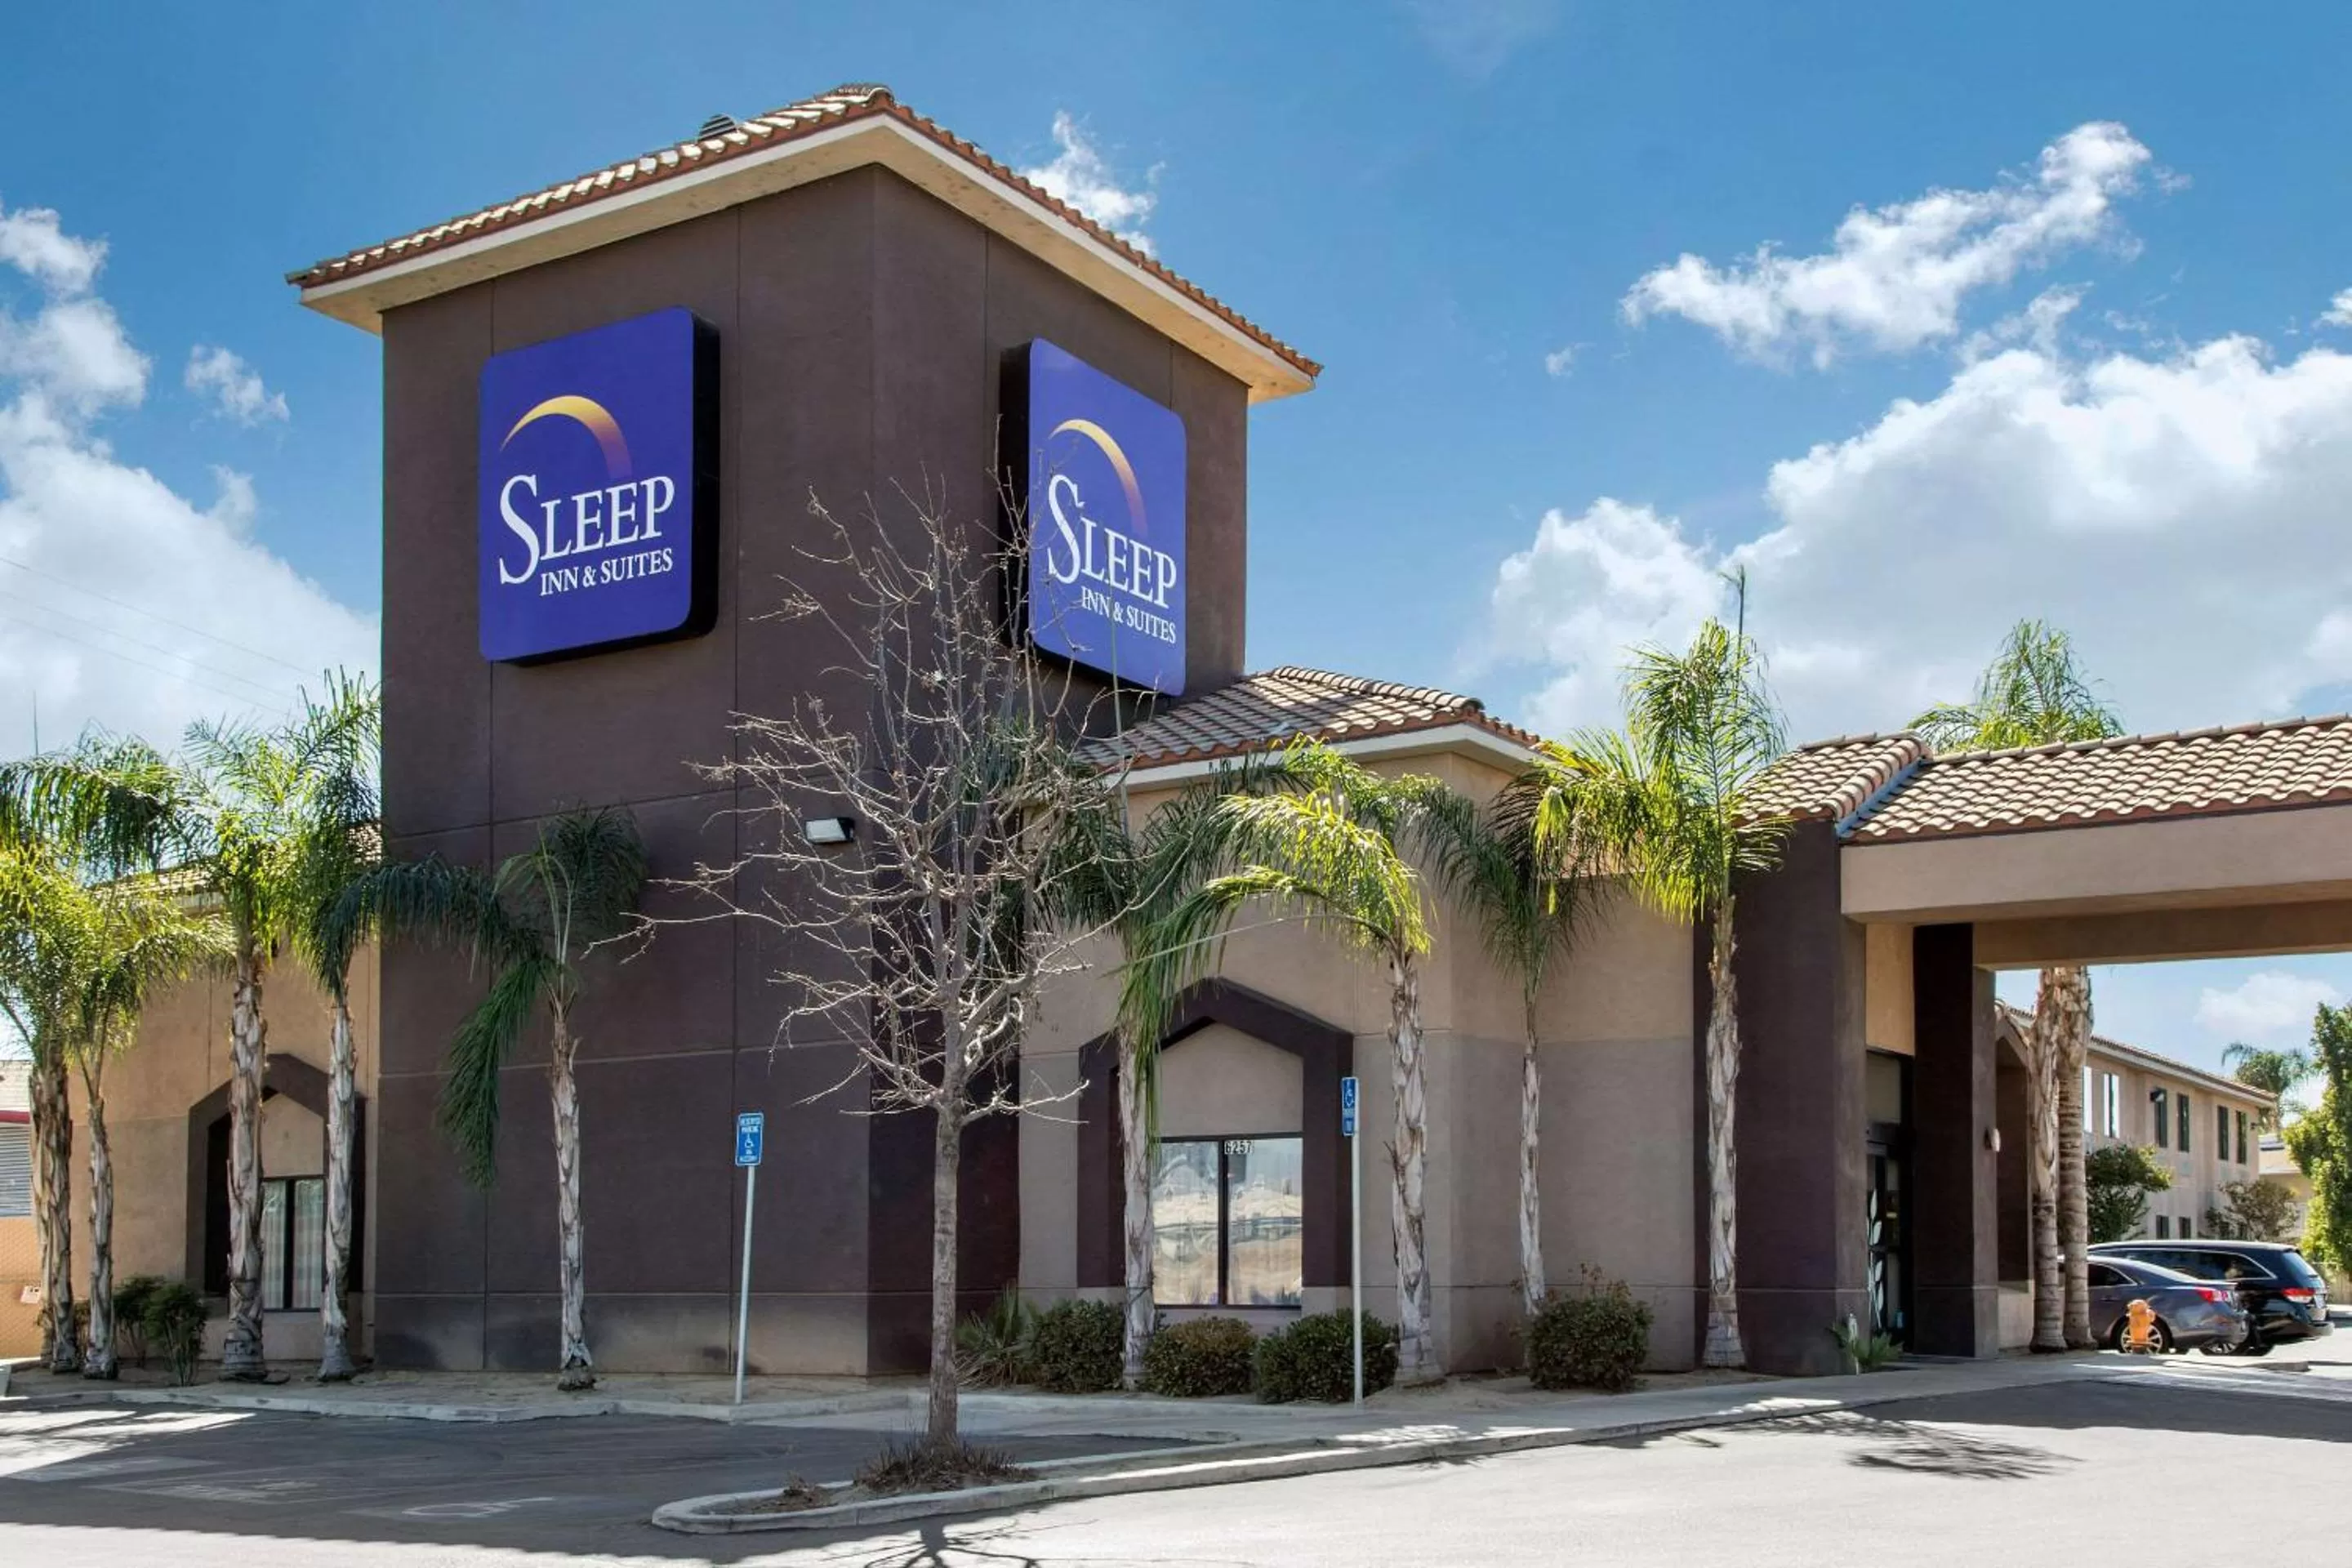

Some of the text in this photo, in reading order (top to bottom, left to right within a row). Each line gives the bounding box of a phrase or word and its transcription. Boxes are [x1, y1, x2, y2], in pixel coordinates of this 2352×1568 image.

[500, 474, 675, 584] SLEEP
[1049, 474, 1177, 608] SLEEP
[541, 548, 673, 596] INN & SUITES
[1081, 586, 1176, 644] INN & SUITES
[1225, 1140, 1253, 1154] 6257
